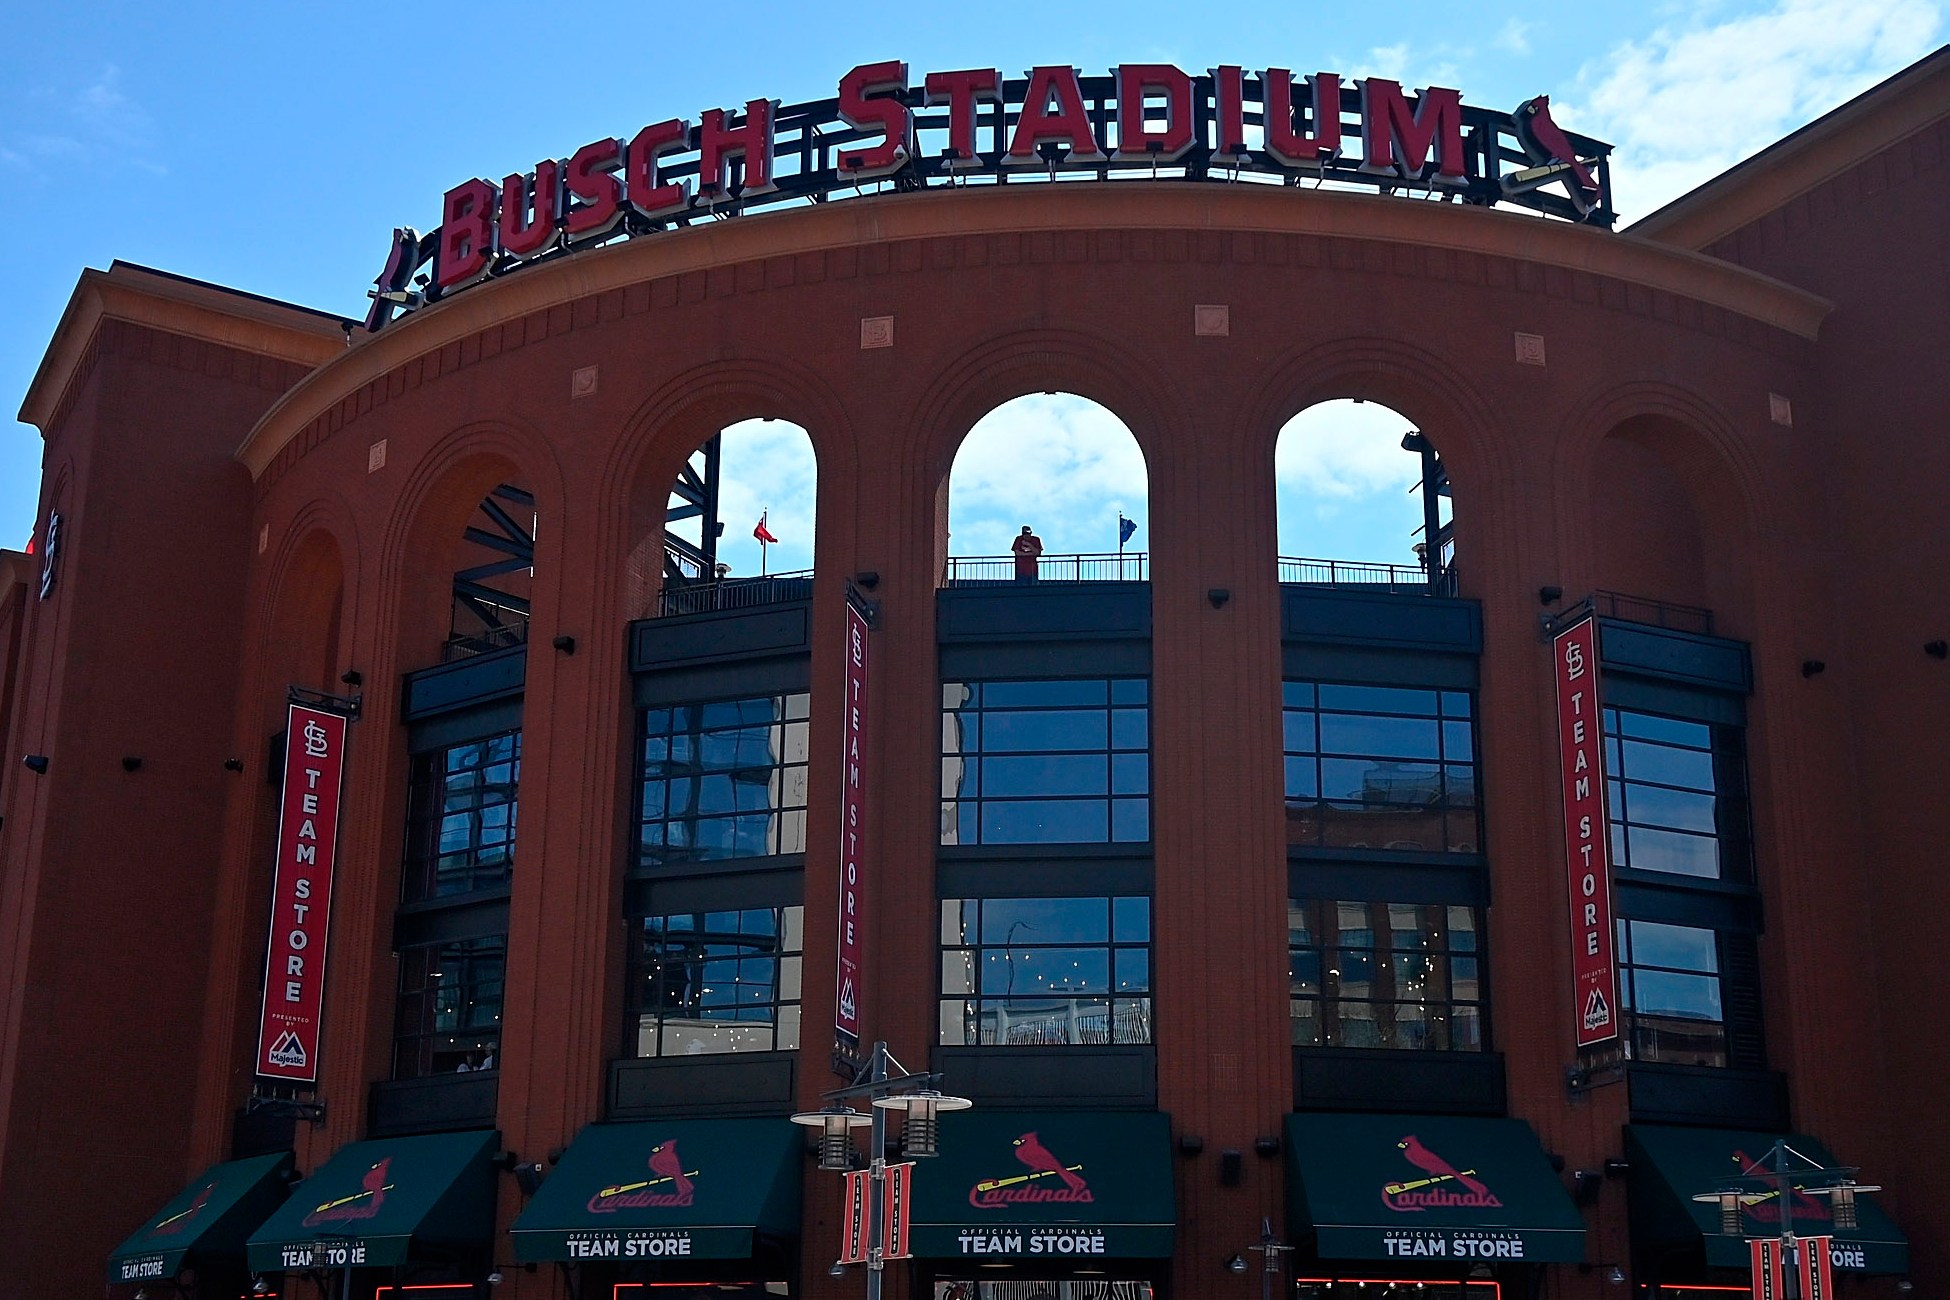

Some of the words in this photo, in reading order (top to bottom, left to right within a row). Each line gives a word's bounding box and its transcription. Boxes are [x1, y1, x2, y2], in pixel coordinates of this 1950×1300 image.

[437, 98, 780, 295] BUSCH
[837, 60, 1468, 187] STADIUM
[849, 677, 860, 789] TEAM
[1571, 691, 1590, 801] TEAM
[296, 768, 321, 866] TEAM
[846, 803, 857, 946] STORE
[1579, 815, 1598, 956] STORE
[286, 878, 310, 1003] STORE
[271, 1053, 304, 1065] Majestic
[587, 1184, 695, 1214] Cardinals
[969, 1179, 1095, 1208] Cardinals
[1381, 1181, 1503, 1212] Cardinals
[627, 1231, 690, 1239] CARDINALS
[958, 1236, 1022, 1254] TEAM
[1029, 1236, 1105, 1254] STORE
[1031, 1228, 1103, 1236] CARDINALS
[1386, 1231, 1443, 1239] OFFICIAL
[1453, 1232, 1520, 1240] CARDINALS
[566, 1239, 619, 1257] TEAM
[625, 1238, 691, 1257] STORE
[1383, 1238, 1446, 1256] TEAM
[1453, 1239, 1524, 1258] STORE
[121, 1263, 139, 1280] TEAM
[139, 1260, 164, 1277] STORE
